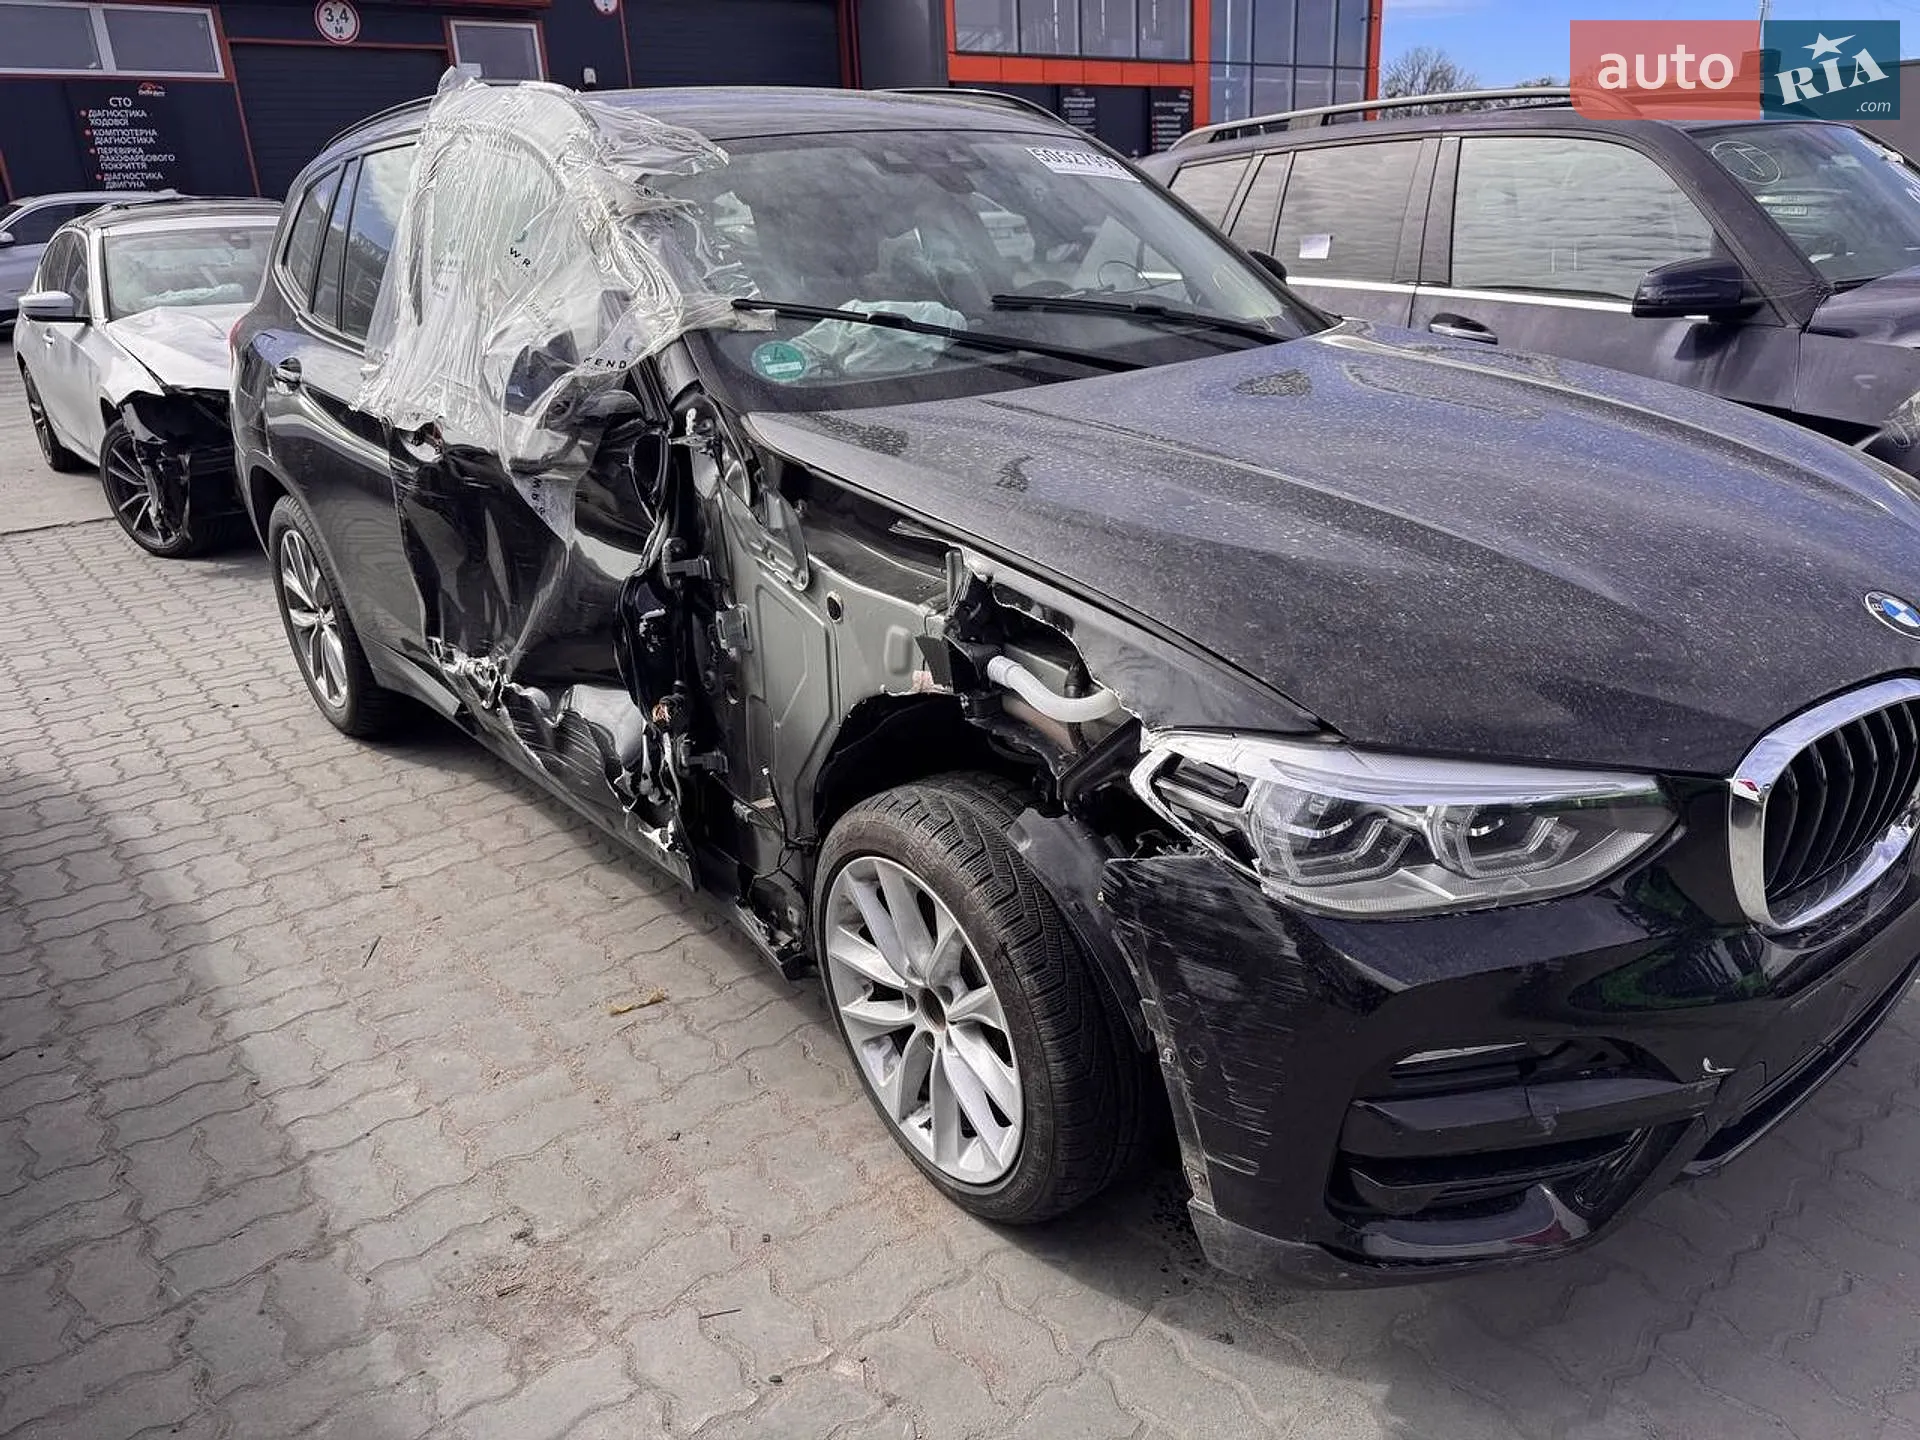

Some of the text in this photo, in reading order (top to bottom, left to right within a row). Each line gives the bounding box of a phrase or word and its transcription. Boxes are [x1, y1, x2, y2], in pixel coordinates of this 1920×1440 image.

[109, 97, 132, 107] СТО
[88, 109, 147, 118] ДІАГНОСТИКА
[94, 136, 156, 145] ДІАГНОСТИКА
[97, 147, 144, 155] ПЕРЕВІРКА
[100, 162, 148, 170] ПОКРИТТЯ
[103, 172, 164, 181] ДІАГНОСТИКА
